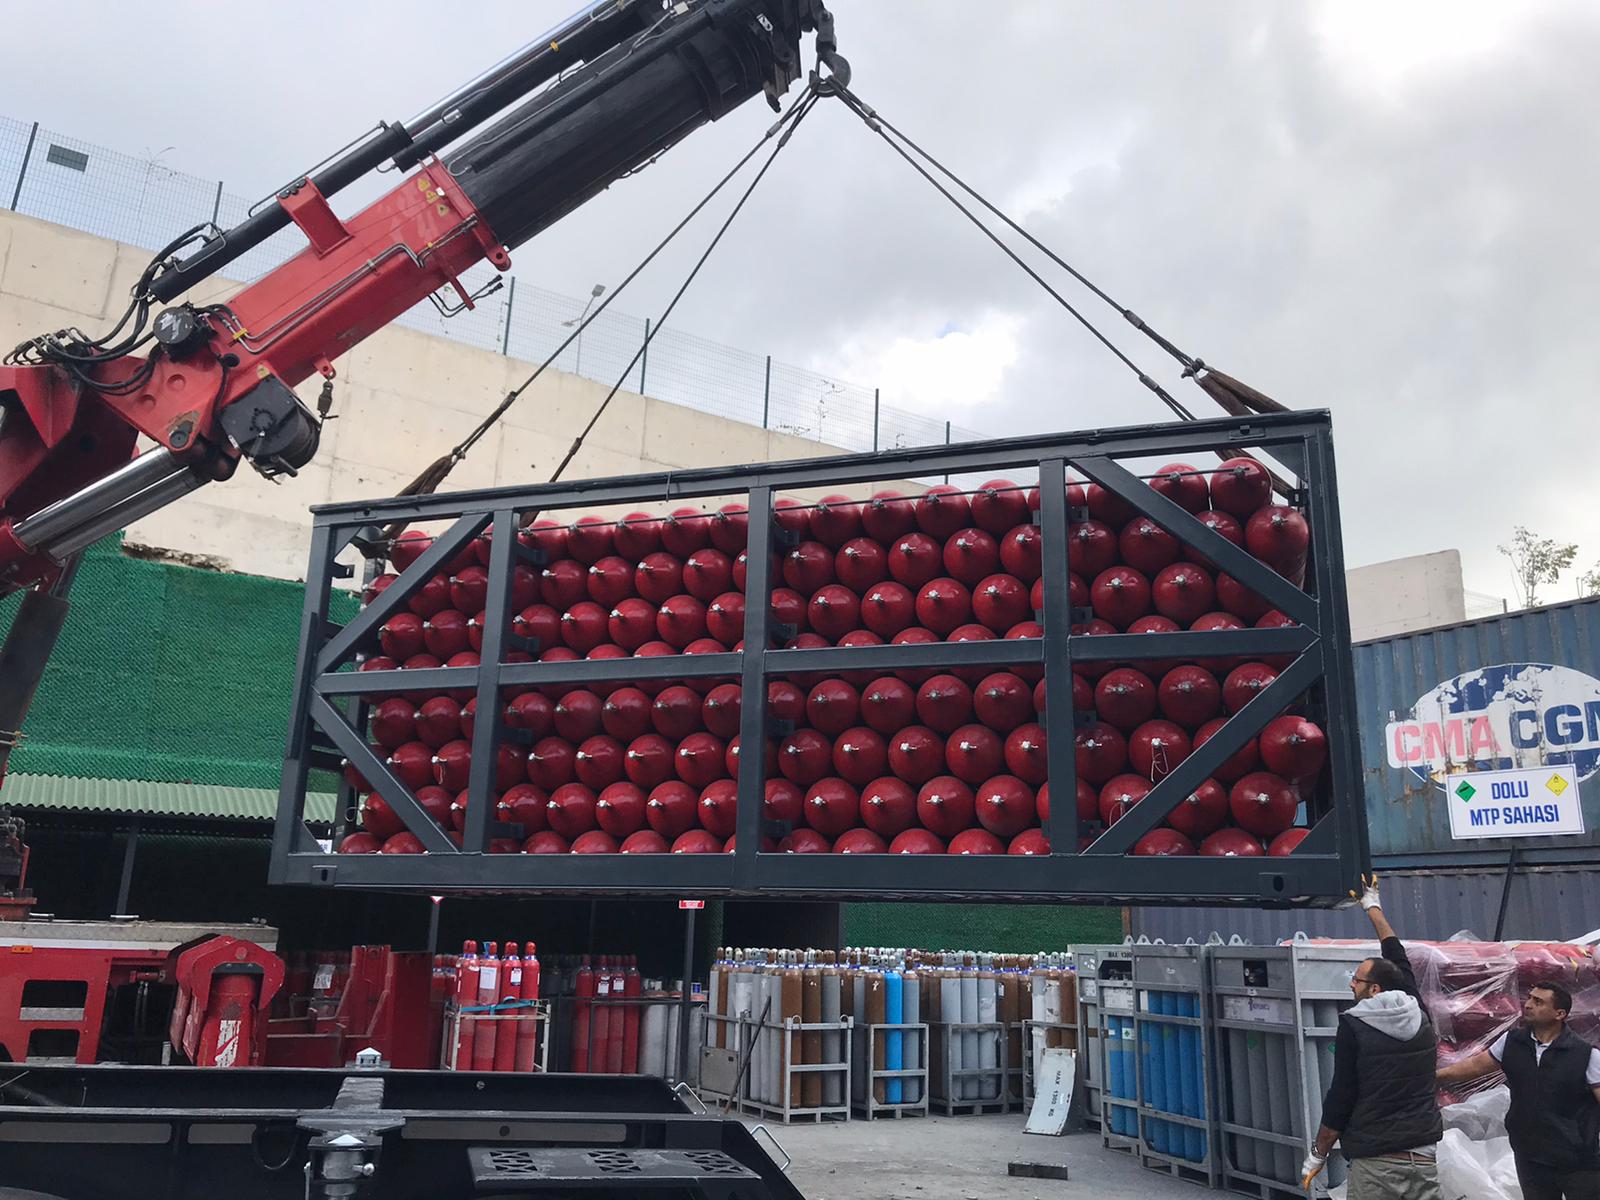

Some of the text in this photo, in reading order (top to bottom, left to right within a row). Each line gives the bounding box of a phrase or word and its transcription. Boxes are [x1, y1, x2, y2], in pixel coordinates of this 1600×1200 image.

[1394, 715, 1502, 762] CMA
[1491, 780, 1529, 800] DOLU
[1470, 804, 1560, 827] MTP SAHASI
